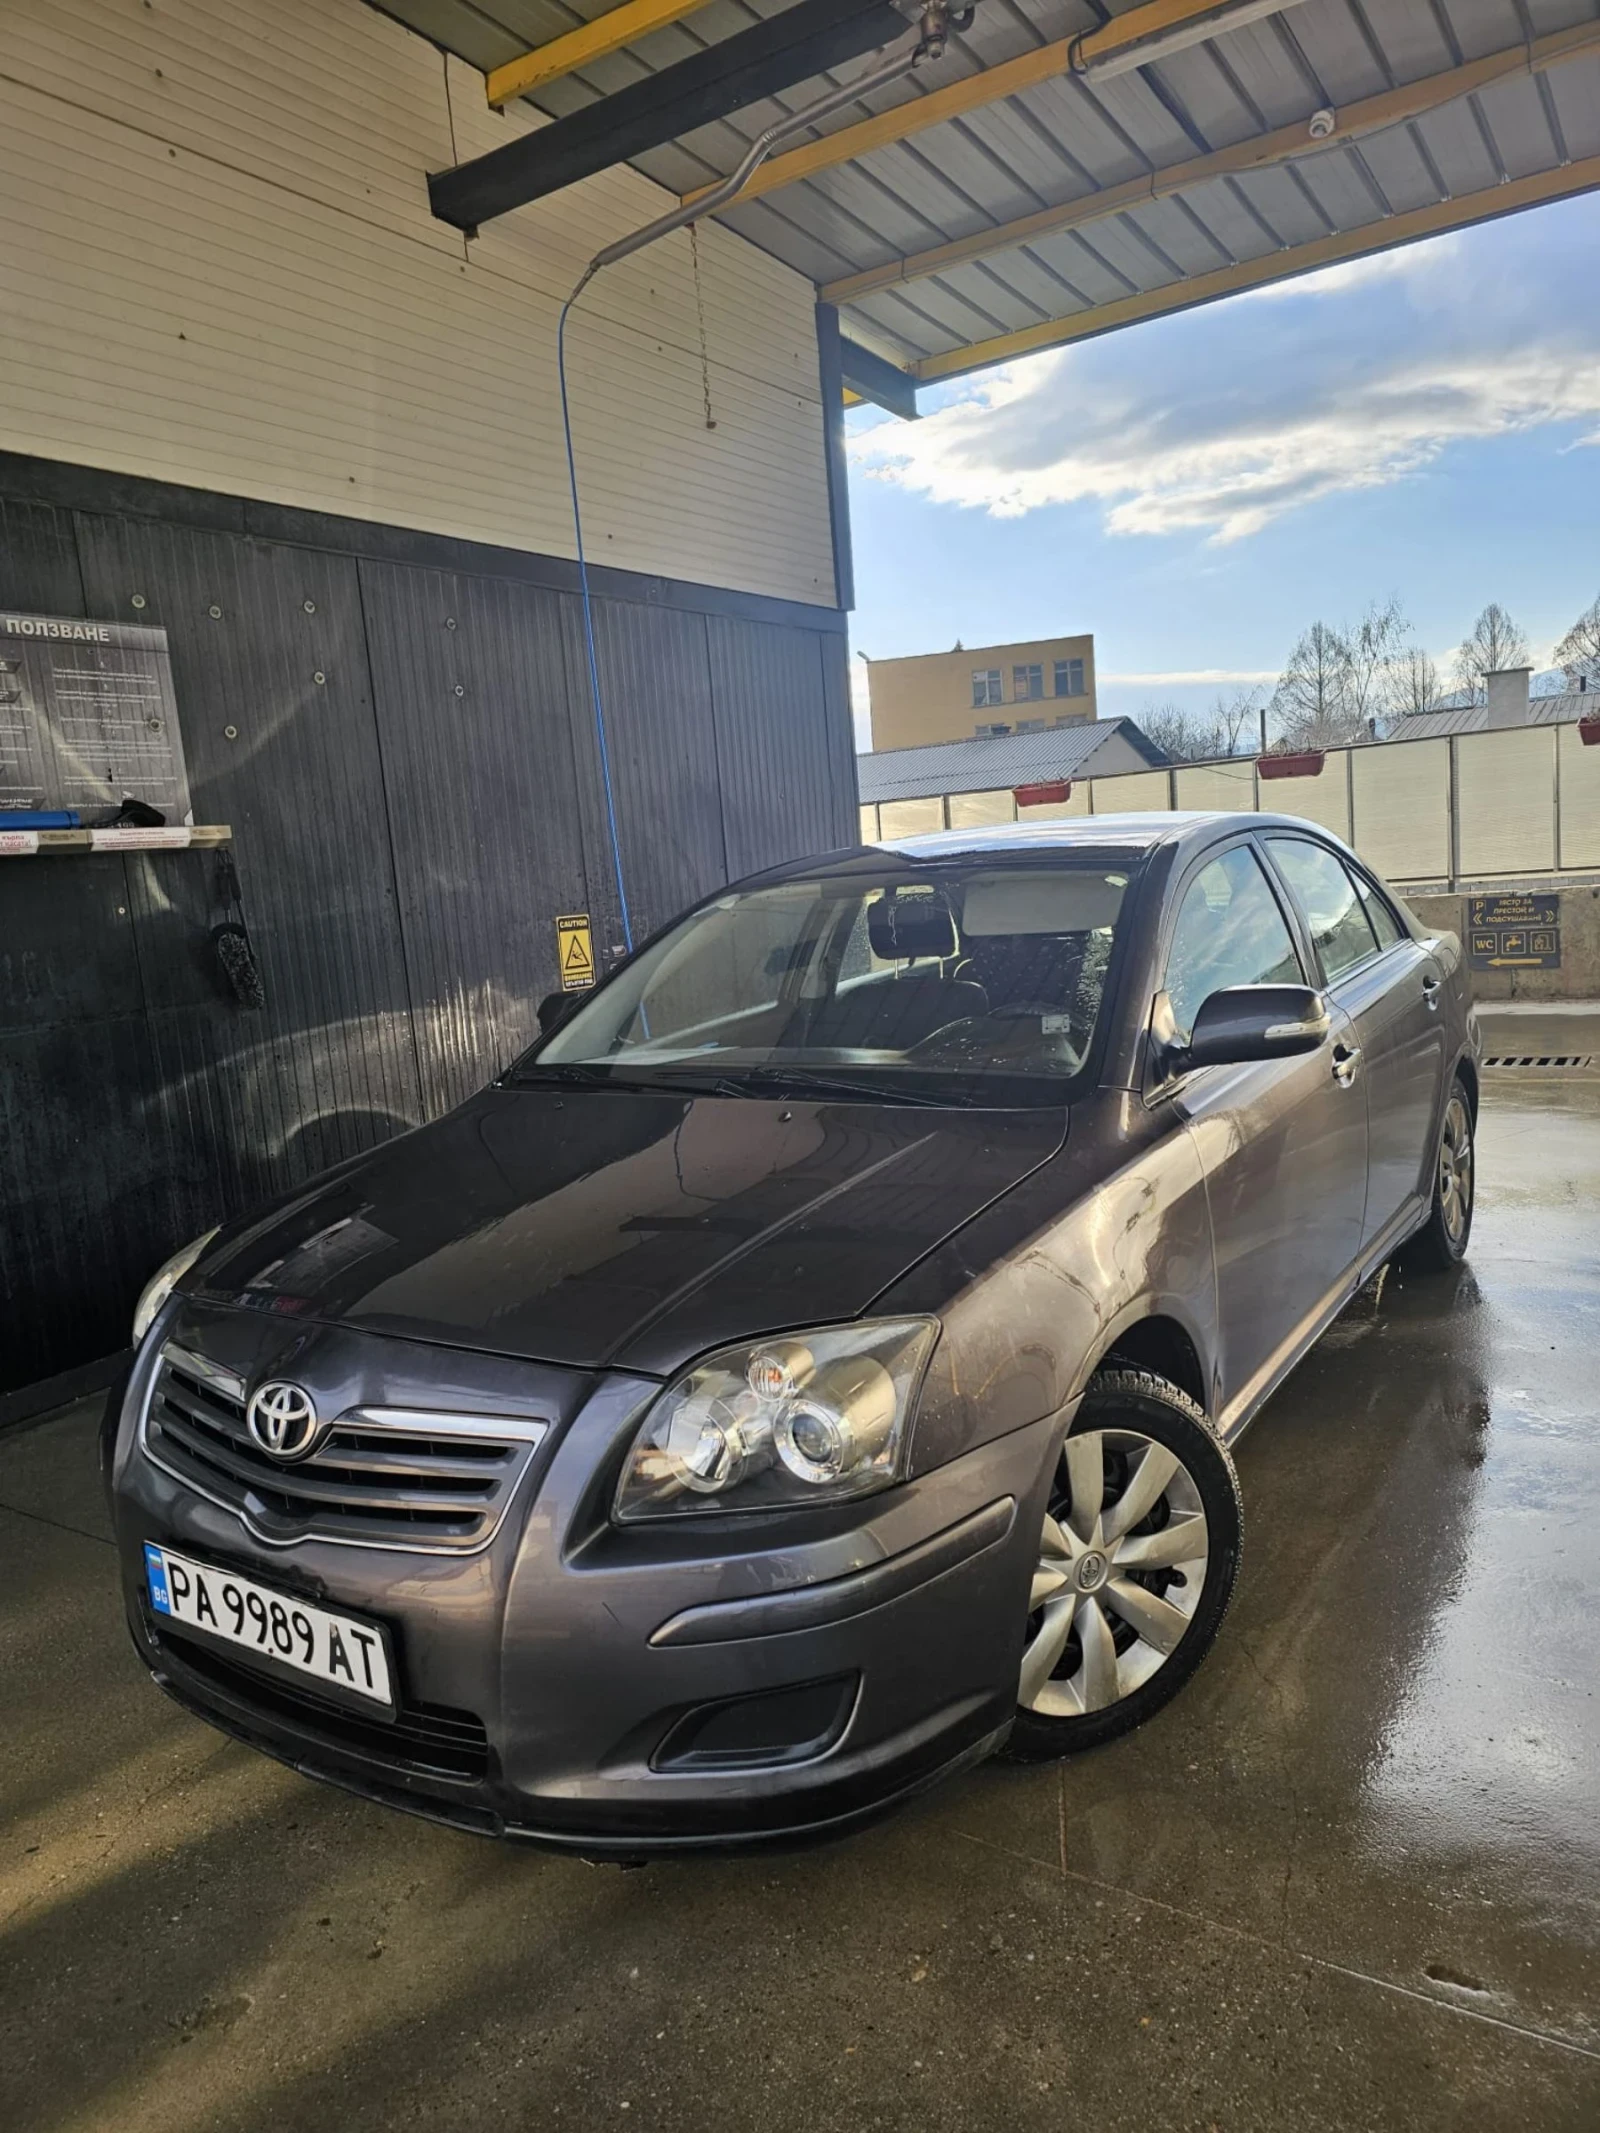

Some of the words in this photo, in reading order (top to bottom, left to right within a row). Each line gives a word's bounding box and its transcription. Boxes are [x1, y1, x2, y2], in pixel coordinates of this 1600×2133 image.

[6, 619, 110, 642] ПОЛЗВАНЕ
[1475, 901, 1484, 911] P
[559, 920, 588, 928] CAUTION
[1476, 939, 1494, 949] WC
[153, 1585, 169, 1605] BG
[167, 1561, 218, 1628] PA
[222, 1583, 315, 1664] 9989
[328, 1620, 375, 1689] AT
